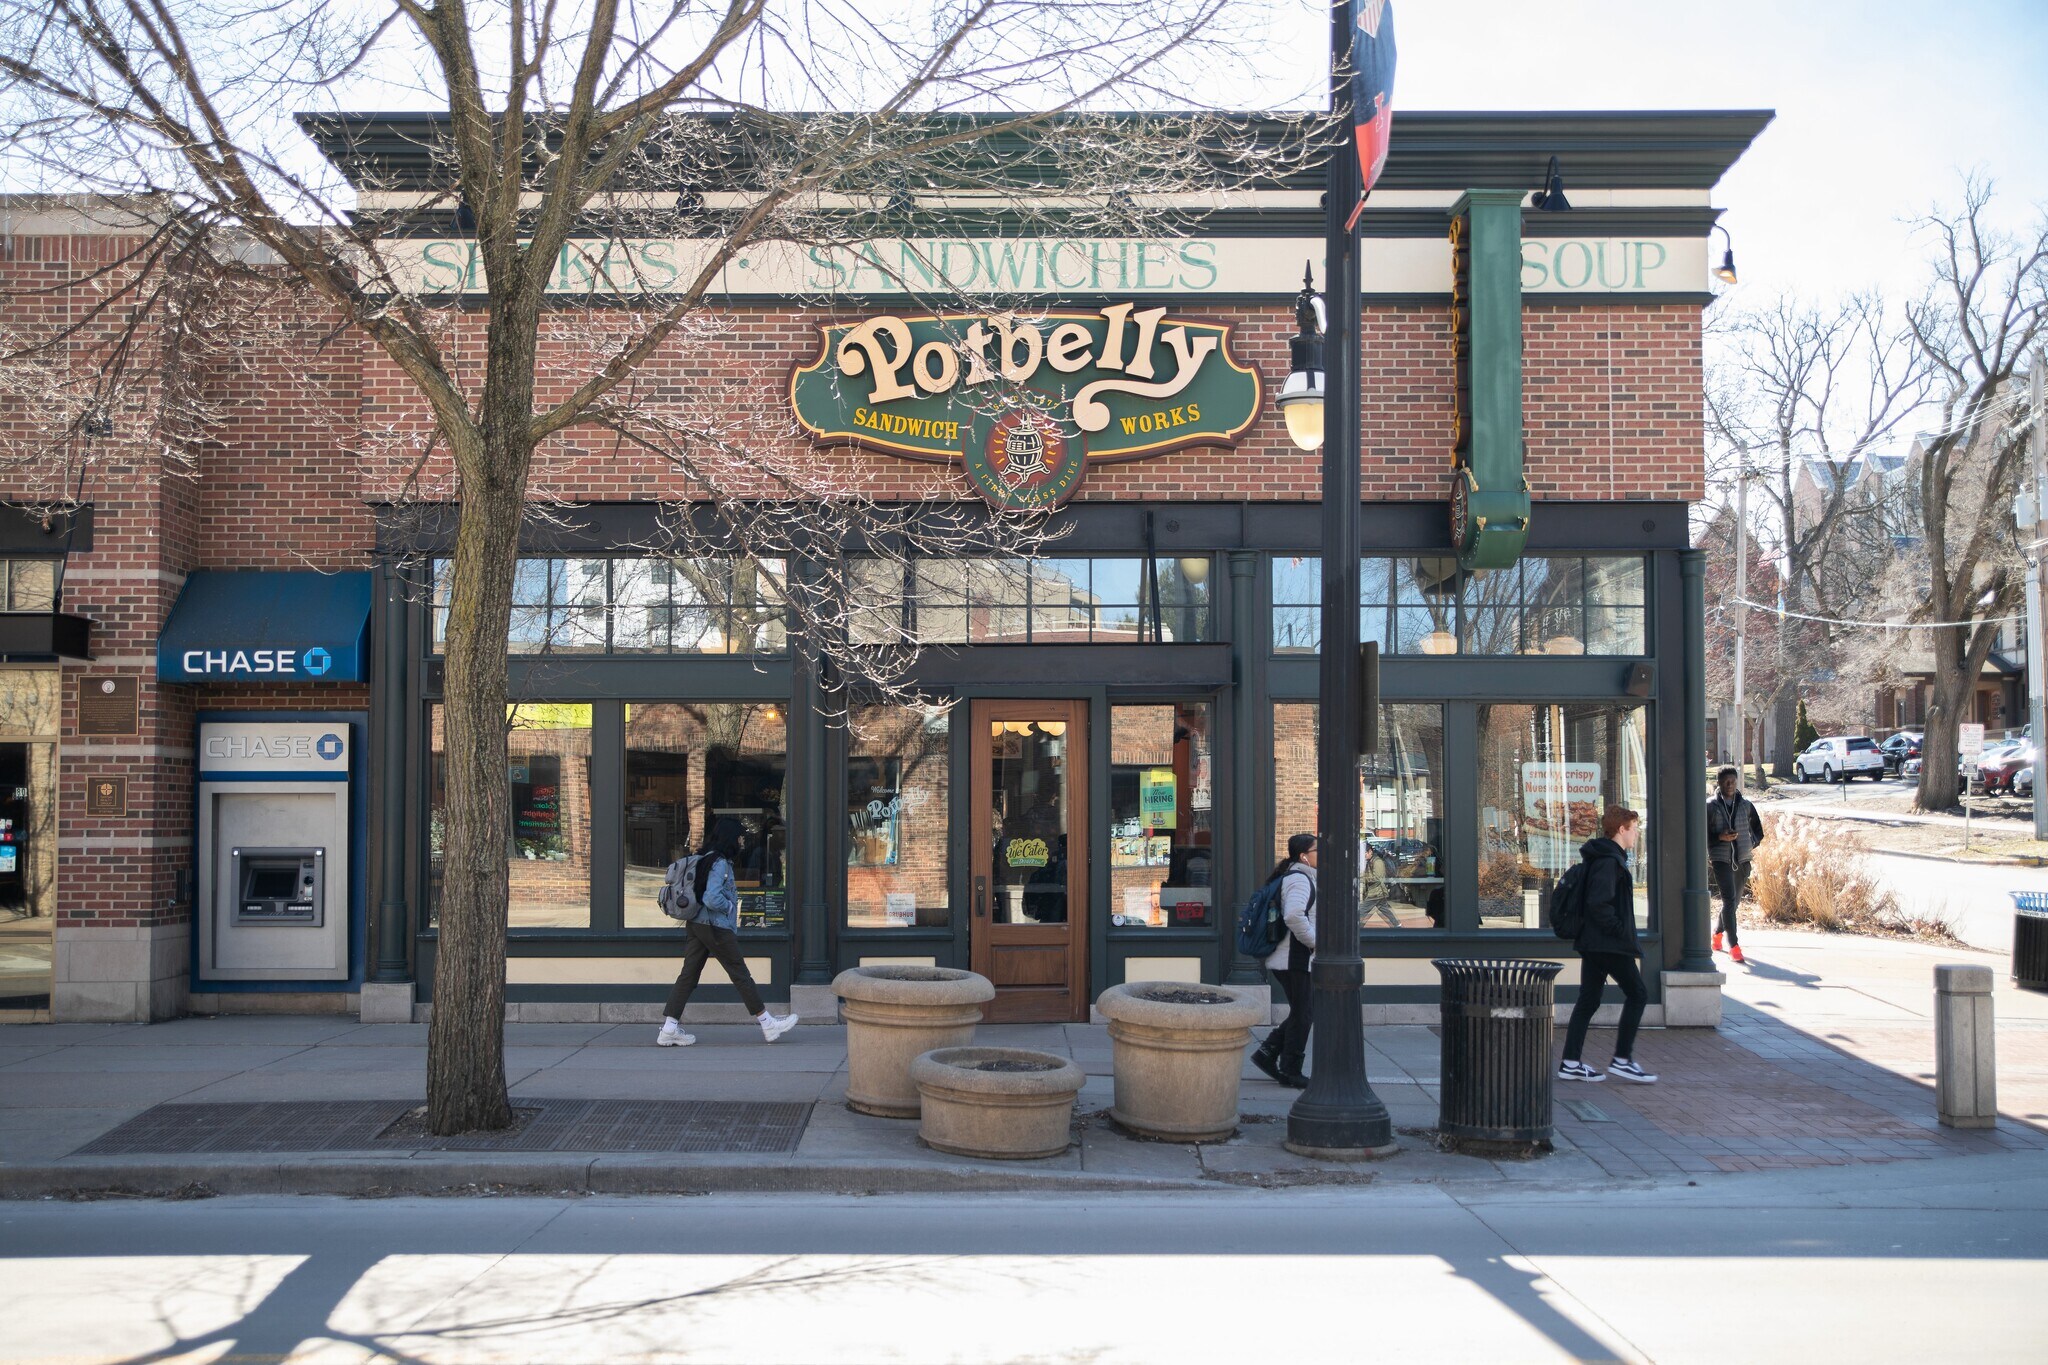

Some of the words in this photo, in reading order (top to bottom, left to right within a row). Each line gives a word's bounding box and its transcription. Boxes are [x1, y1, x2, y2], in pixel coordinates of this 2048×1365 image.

[423, 242, 679, 290] SKES
[808, 241, 1218, 290] SANDWICHES
[1521, 241, 1666, 289] SOUP
[836, 302, 1218, 432] Potbelly
[853, 408, 958, 440] SANDWICH
[1120, 403, 1201, 435] WORKS
[1059, 461, 1078, 488] DIVE
[183, 651, 296, 673] CHASE
[206, 736, 312, 759] CHASE
[1565, 769, 1595, 782] crispy
[1567, 782, 1596, 794] bacon
[1144, 795, 1173, 804] HIRING
[1023, 842, 1047, 858] Cater
